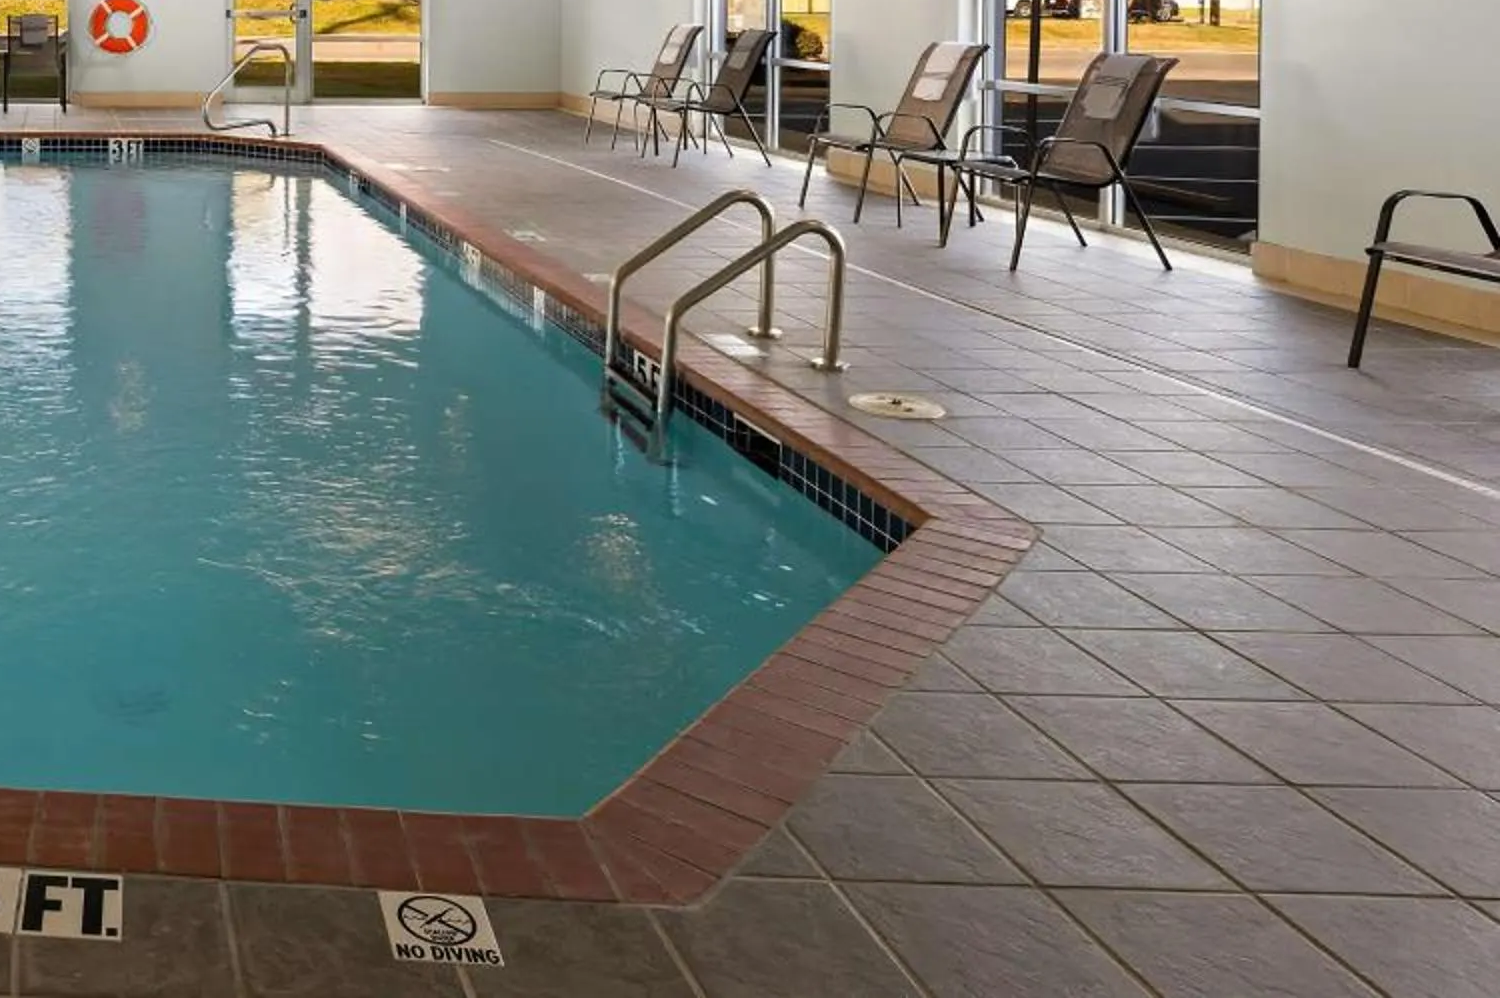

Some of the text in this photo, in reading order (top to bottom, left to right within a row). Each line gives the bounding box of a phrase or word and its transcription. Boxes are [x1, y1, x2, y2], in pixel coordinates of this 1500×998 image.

[112, 139, 124, 154] 3
[637, 355, 647, 382] 5
[21, 874, 119, 936] FT.
[396, 944, 500, 964] NO DIVING
